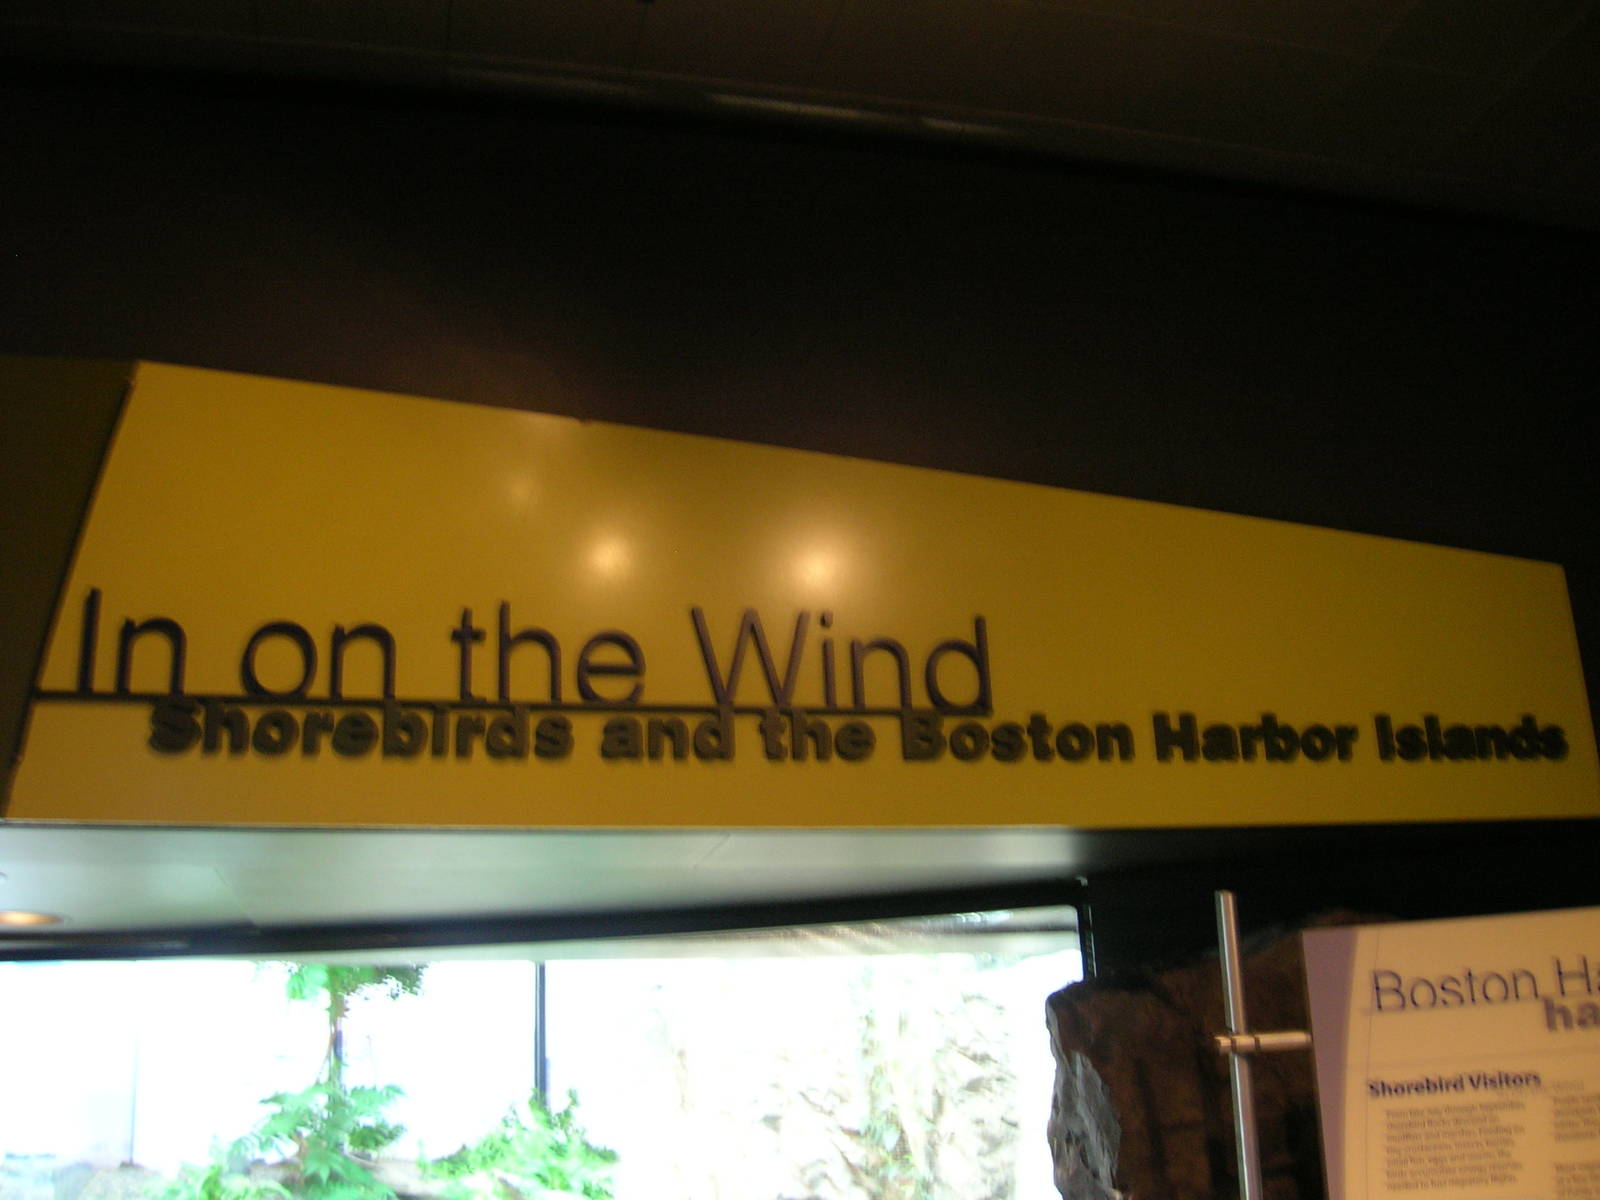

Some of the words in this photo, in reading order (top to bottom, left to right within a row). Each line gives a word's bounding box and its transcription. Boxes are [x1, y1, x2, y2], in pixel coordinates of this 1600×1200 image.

[77, 587, 188, 697] In
[242, 620, 397, 701] on
[452, 600, 645, 707] the
[690, 604, 993, 716] Wind
[149, 698, 575, 760] Shorebirds
[600, 706, 735, 762] and
[758, 706, 877, 762] the
[901, 710, 1136, 762] Boston
[1151, 710, 1358, 762] Harbor
[1374, 711, 1569, 762] Islands
[1371, 965, 1539, 1011] Boston
[1368, 1075, 1465, 1098] Shorebird
[1468, 1070, 1542, 1091] Visitors
